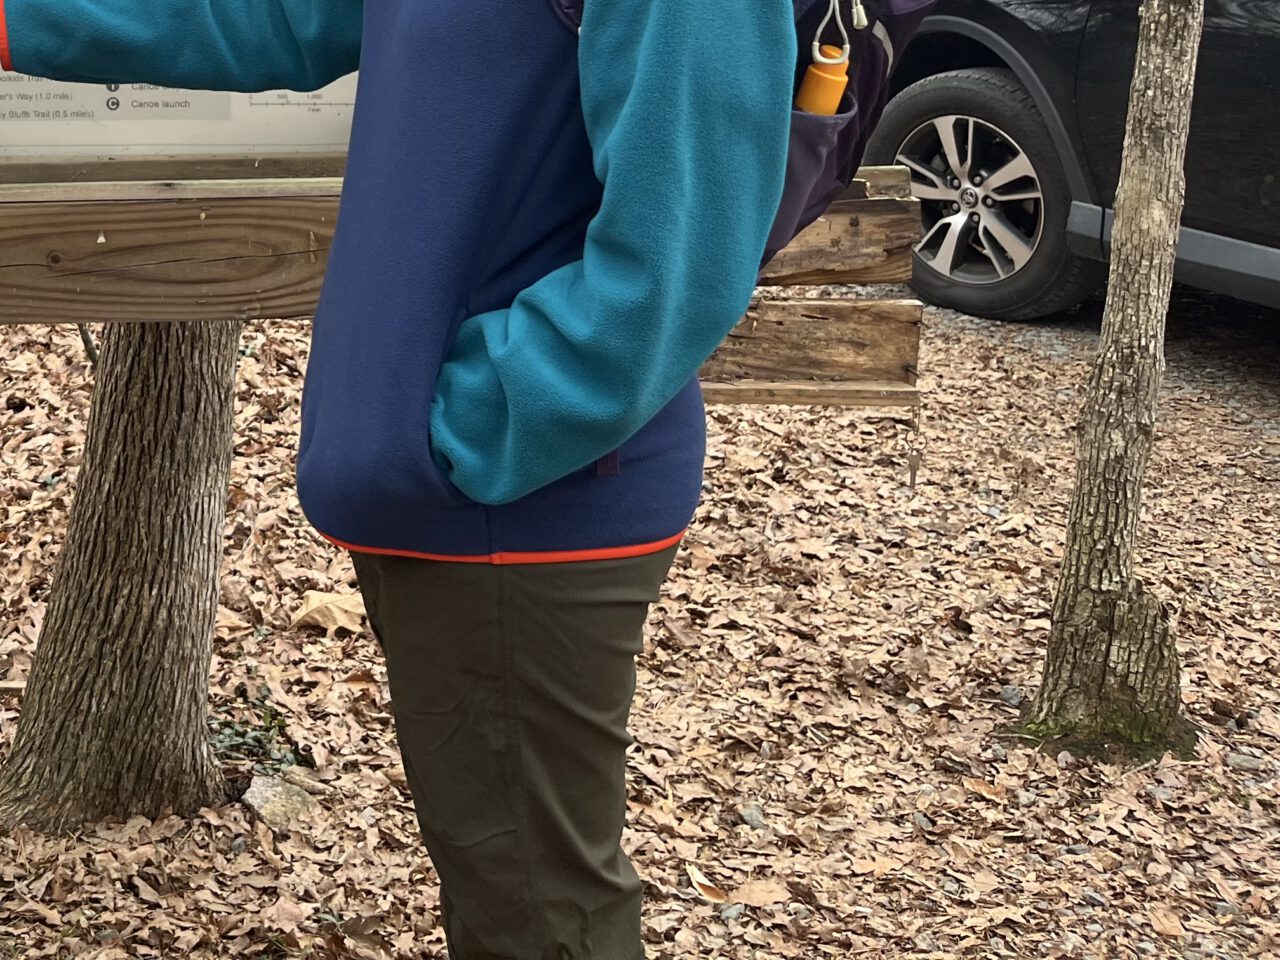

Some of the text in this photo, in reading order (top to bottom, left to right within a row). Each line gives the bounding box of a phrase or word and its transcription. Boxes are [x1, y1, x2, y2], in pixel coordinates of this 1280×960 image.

[16, 93, 33, 102] Way
[131, 100, 160, 108] Canoe
[162, 100, 190, 108] launch
[34, 110, 50, 118] Trail
